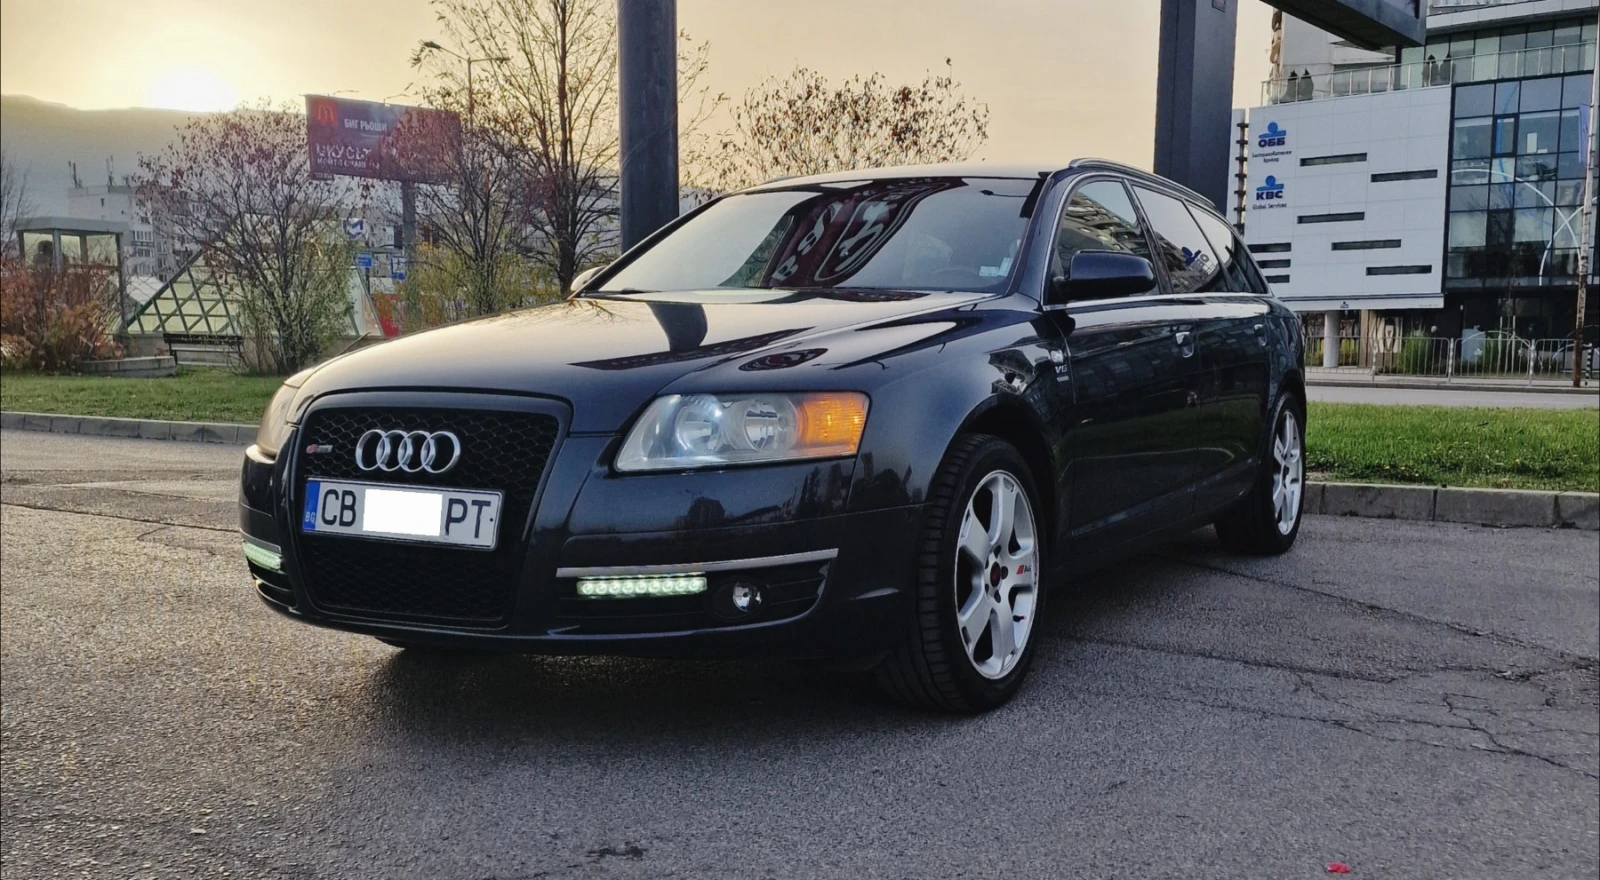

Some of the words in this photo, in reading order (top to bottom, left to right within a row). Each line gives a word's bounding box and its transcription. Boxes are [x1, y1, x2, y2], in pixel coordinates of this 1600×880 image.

[344, 118, 359, 129] БИГ
[1258, 137, 1285, 148] ОББ
[1256, 190, 1283, 200] KBC
[304, 511, 316, 523] BG
[321, 488, 356, 527] CB
[445, 497, 491, 539] PT
